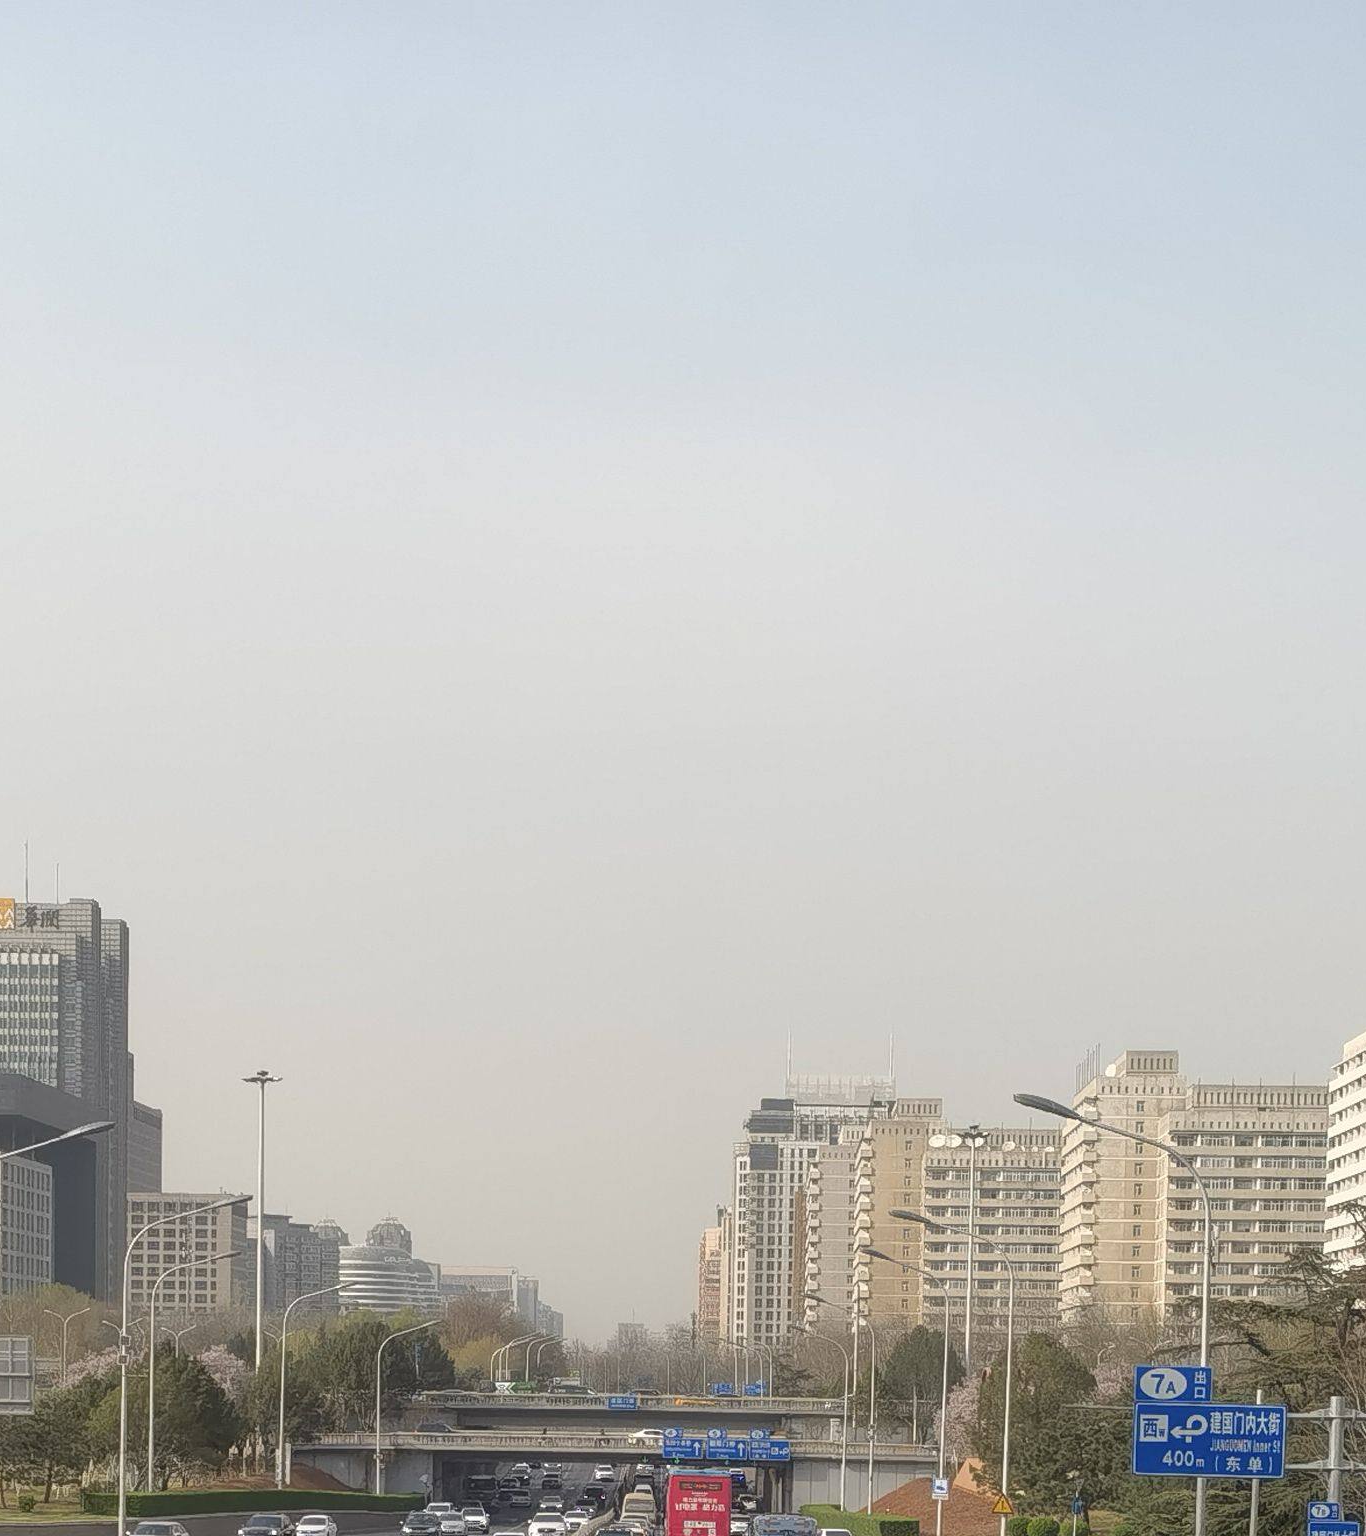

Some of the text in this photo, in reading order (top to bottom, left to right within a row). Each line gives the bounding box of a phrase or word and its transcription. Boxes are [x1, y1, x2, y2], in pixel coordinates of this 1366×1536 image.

[1150, 1373, 1177, 1395] 7A
[1194, 1370, 1207, 1399] 出口
[1209, 1411, 1281, 1436] 建国门内大街
